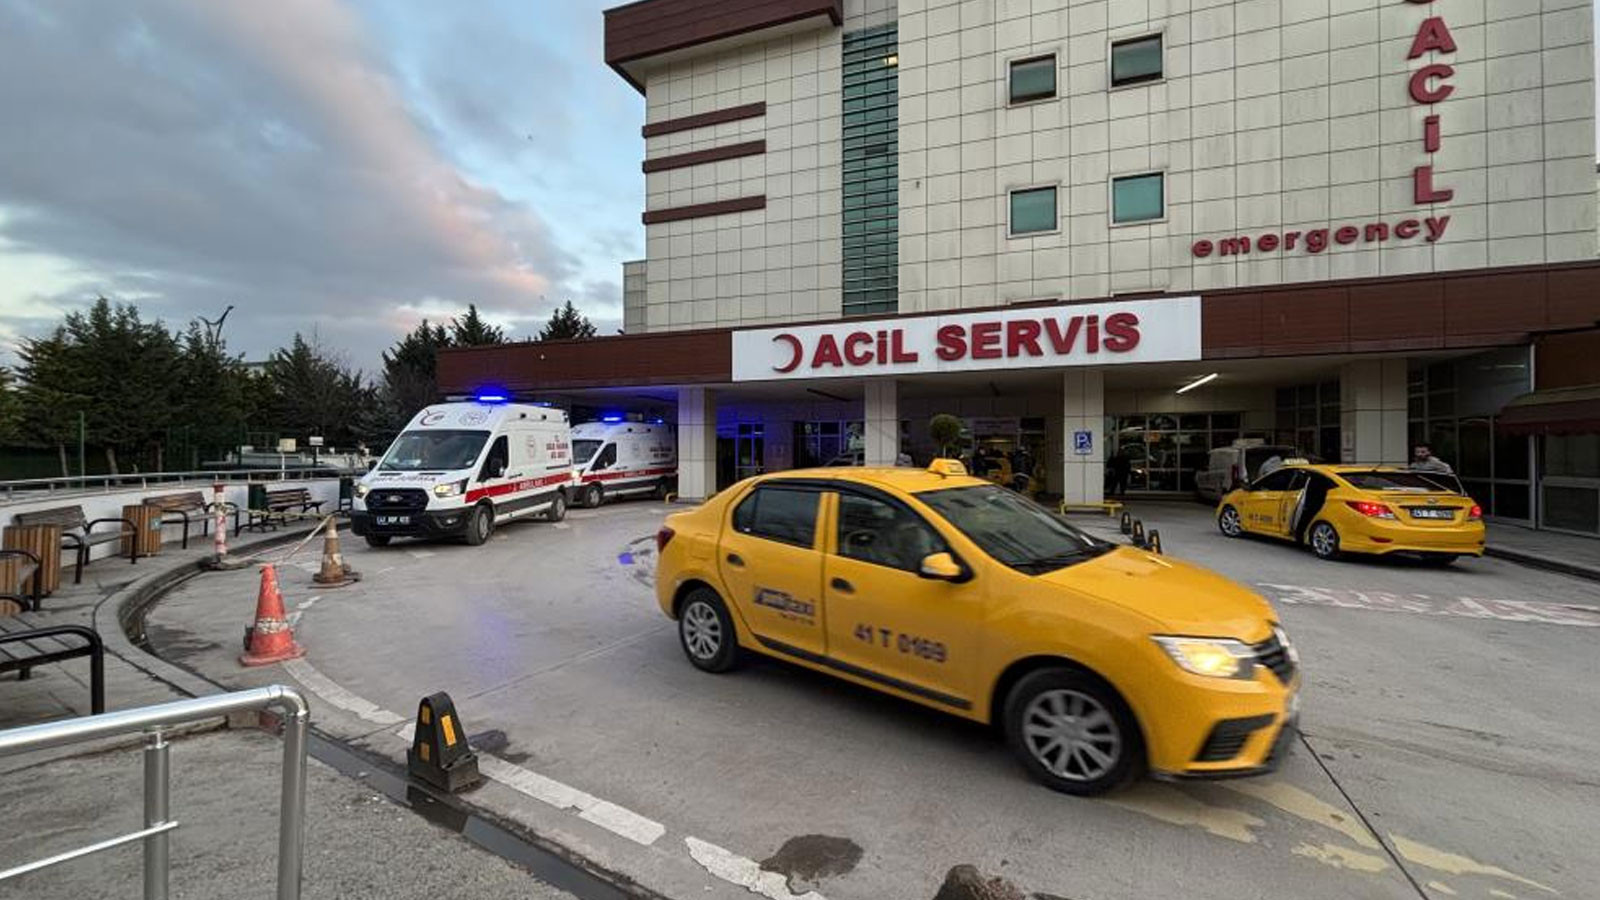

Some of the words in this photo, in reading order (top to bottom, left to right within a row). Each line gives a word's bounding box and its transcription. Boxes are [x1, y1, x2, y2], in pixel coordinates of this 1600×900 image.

[1191, 214, 1451, 258] emergency
[854, 623, 874, 644] 41
[878, 627, 892, 648] T
